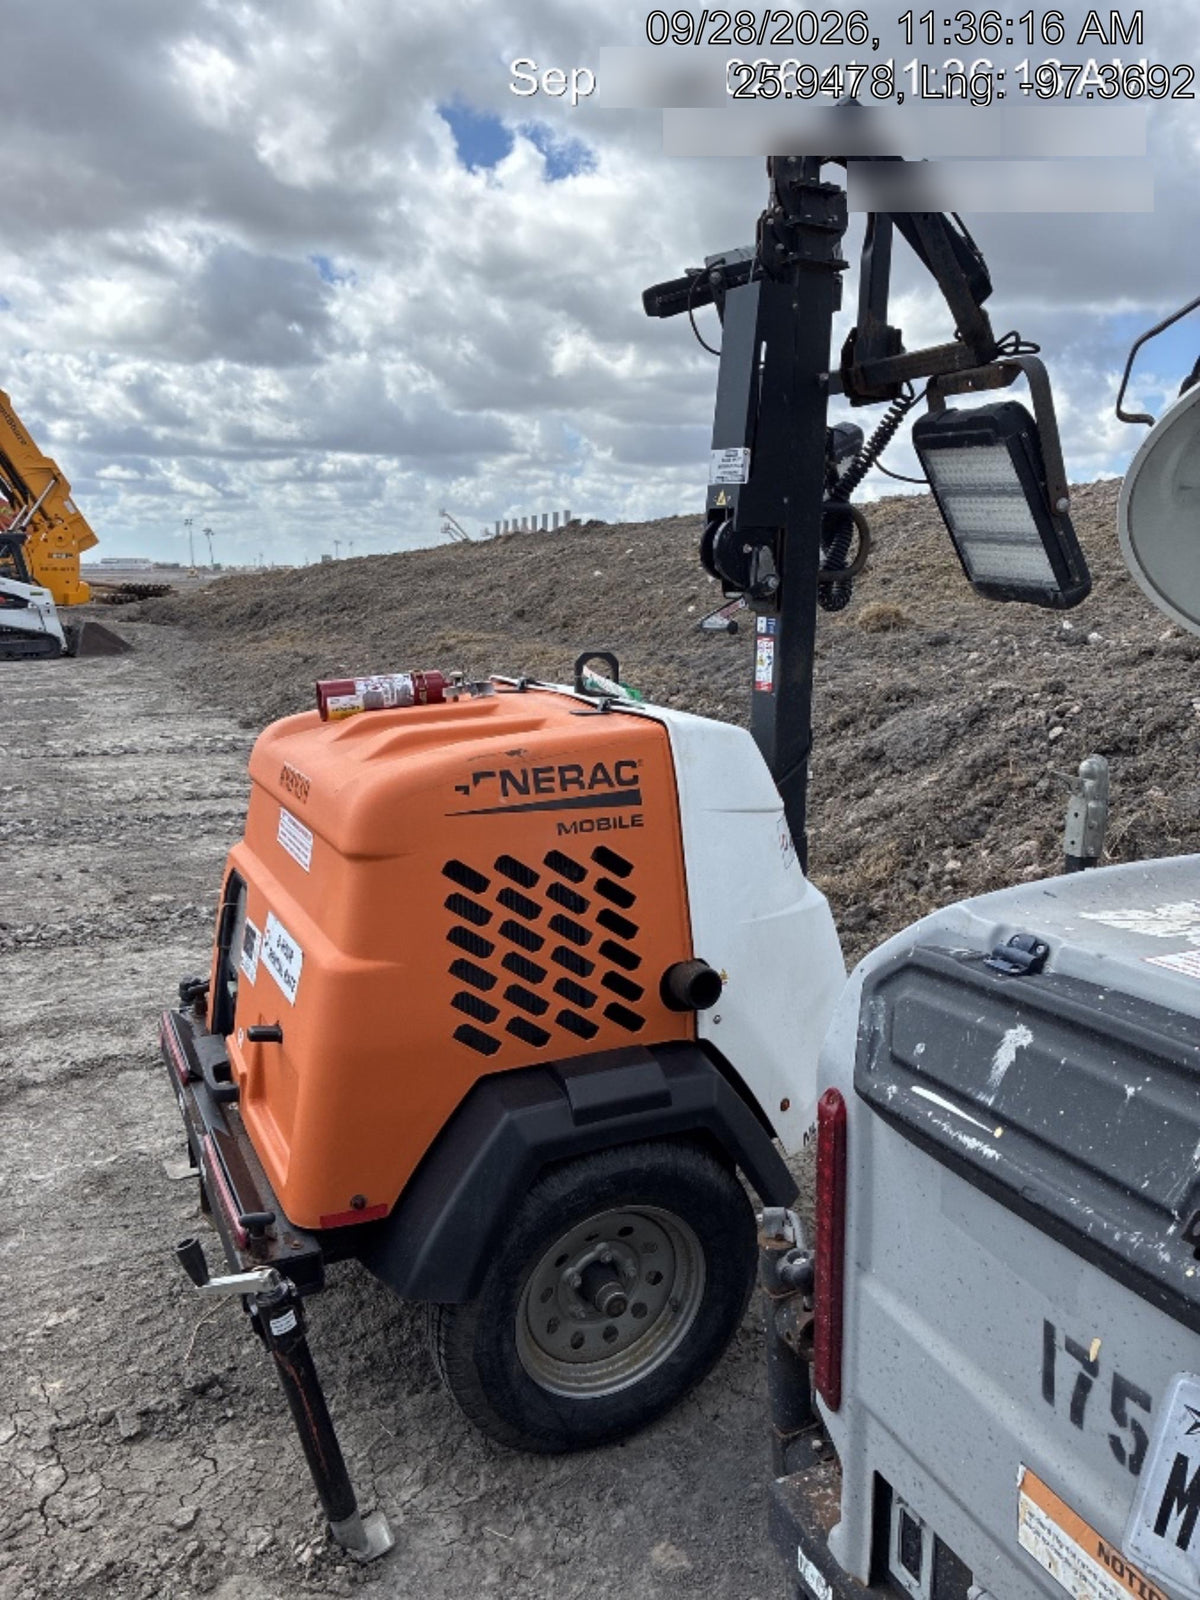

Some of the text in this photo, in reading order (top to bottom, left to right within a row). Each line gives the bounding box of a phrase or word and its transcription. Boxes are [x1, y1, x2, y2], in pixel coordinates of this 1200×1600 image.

[455, 759, 640, 797] NERAC
[557, 813, 644, 836] MOBILE
[1042, 1317, 1153, 1476] 175
